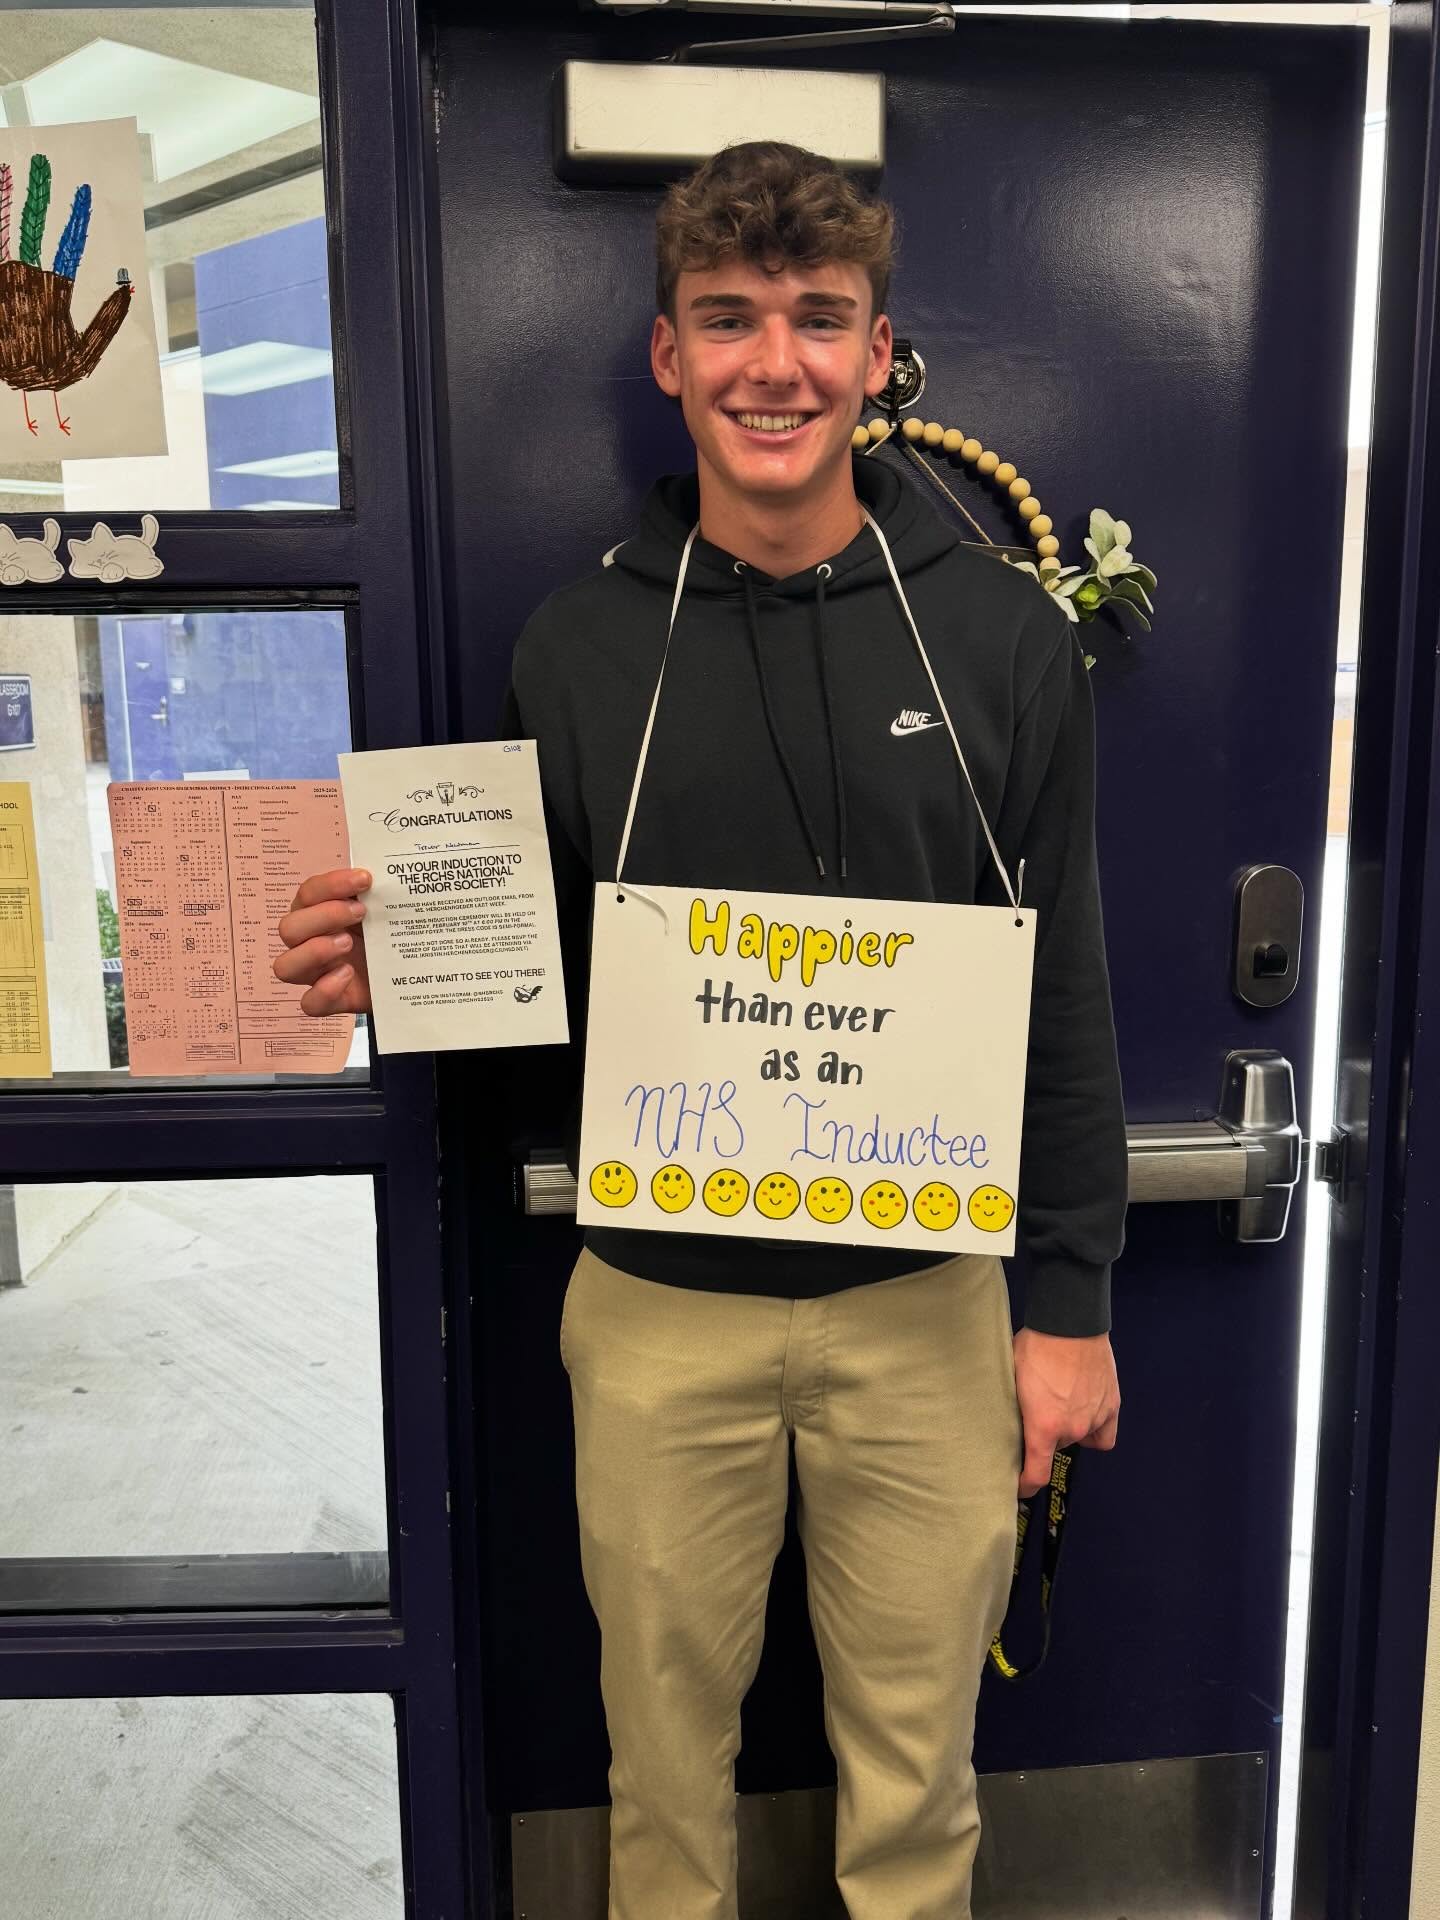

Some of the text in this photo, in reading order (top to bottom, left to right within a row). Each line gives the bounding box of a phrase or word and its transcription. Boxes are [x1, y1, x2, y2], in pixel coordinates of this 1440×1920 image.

[898, 709, 932, 727] NIKE
[368, 808, 513, 833] CONGRATULATIONS
[387, 853, 522, 874] ON YOUR INDUCTION TO
[397, 866, 514, 885] THE RCHS NATIONAL
[408, 876, 506, 895] HONOR SOCIETY!
[688, 898, 914, 987] Happier
[391, 968, 546, 986] WE CANT WAIT TO SEE YOU THERE!
[695, 978, 896, 1033] than ever
[760, 1048, 863, 1085] as an
[625, 1079, 990, 1169] NHS Inductee
[1058, 1456, 1072, 1494] SERIES
